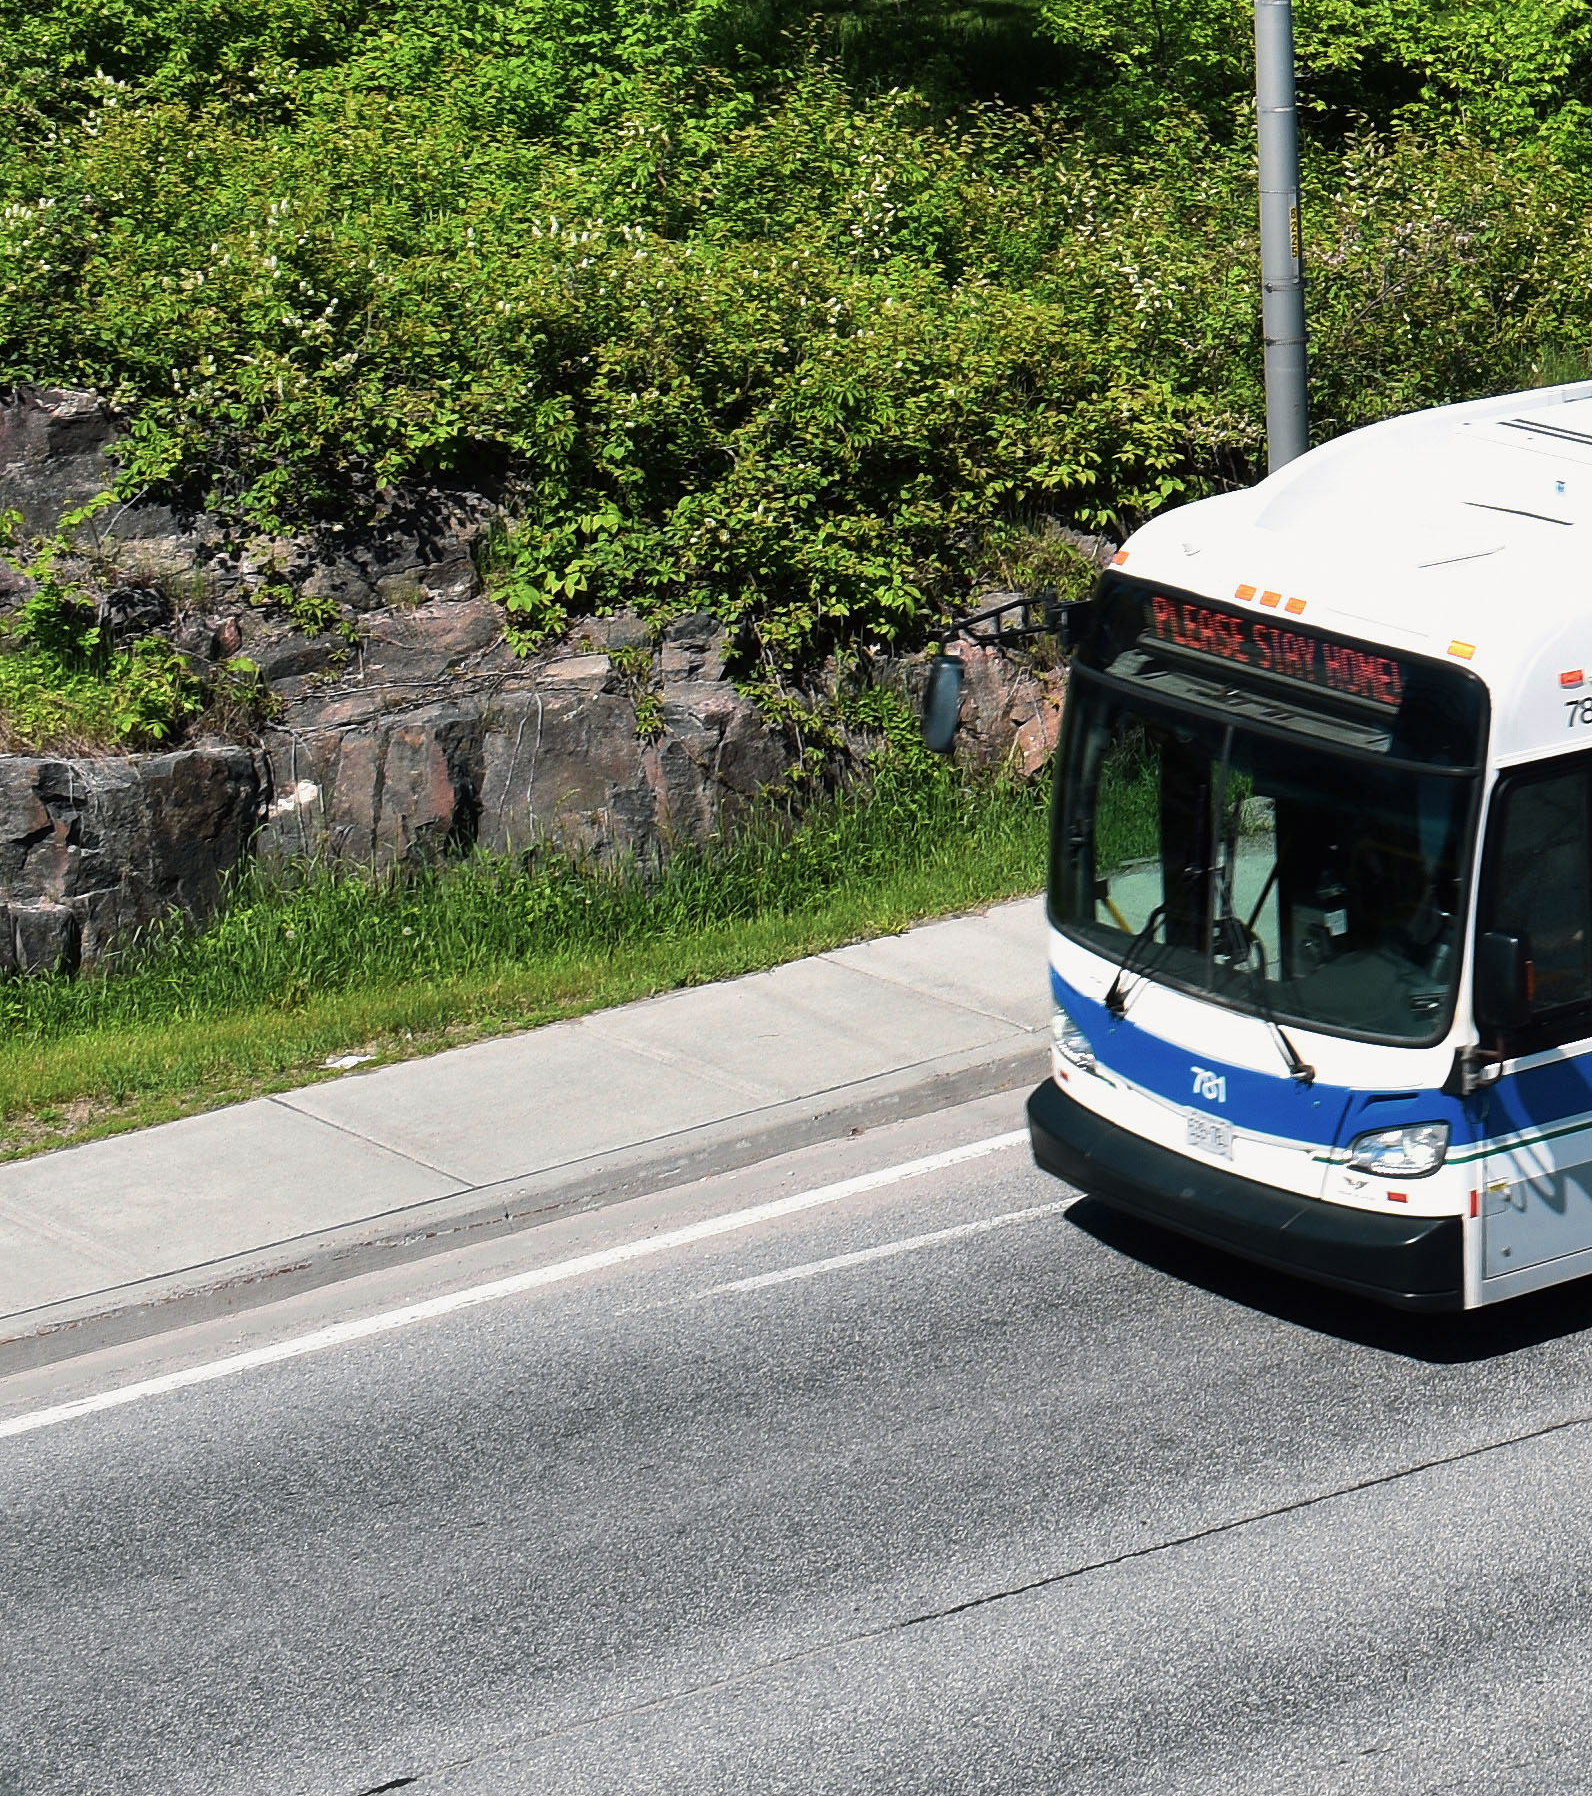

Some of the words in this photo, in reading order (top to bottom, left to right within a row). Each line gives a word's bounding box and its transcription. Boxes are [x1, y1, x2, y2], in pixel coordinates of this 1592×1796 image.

[1151, 595, 1250, 663] PLEASE
[1252, 624, 1317, 683] STAY
[1322, 641, 1403, 704] HOME!
[1189, 1066, 1226, 1103] 781
